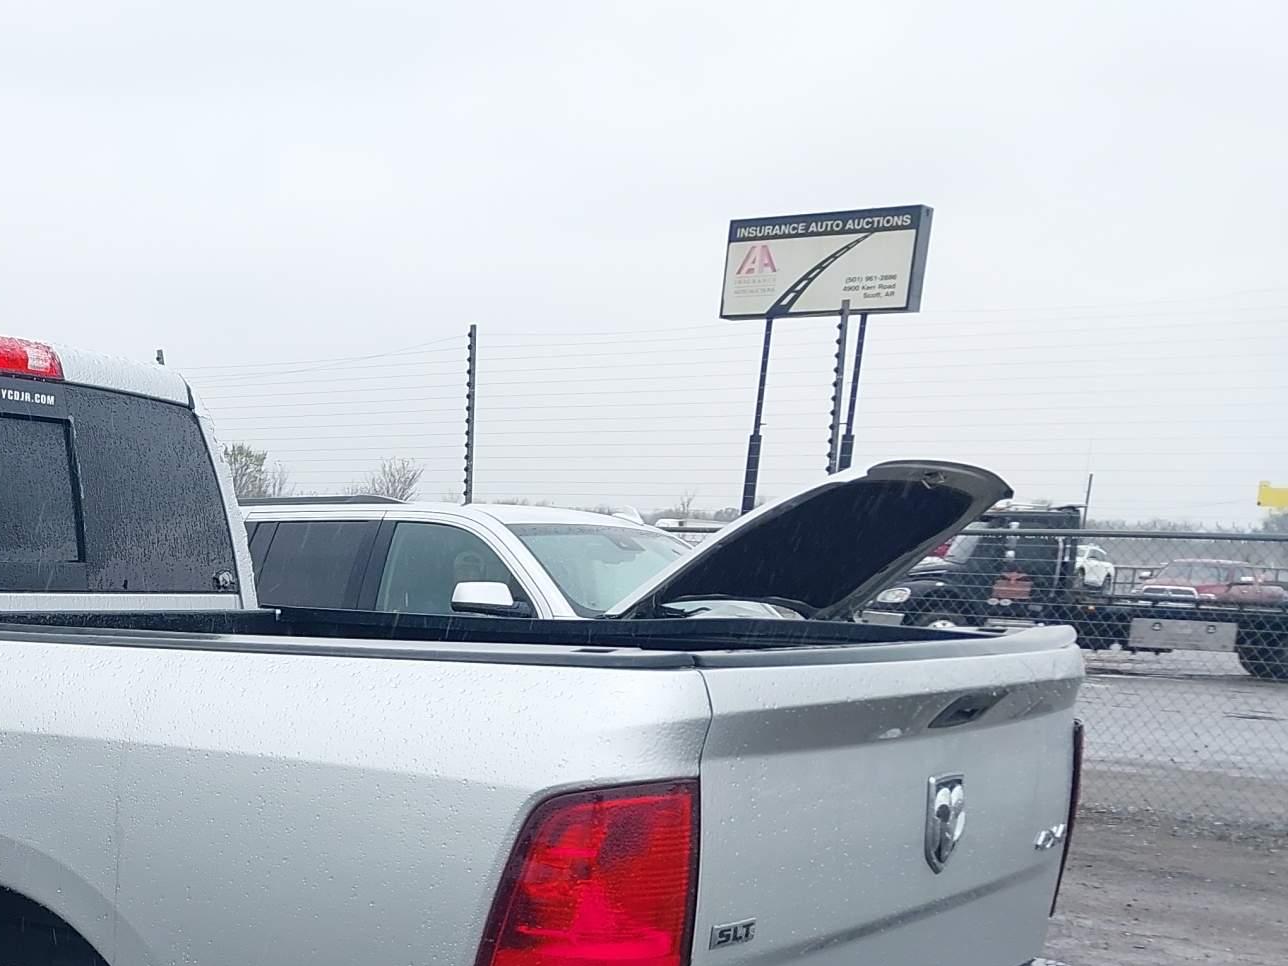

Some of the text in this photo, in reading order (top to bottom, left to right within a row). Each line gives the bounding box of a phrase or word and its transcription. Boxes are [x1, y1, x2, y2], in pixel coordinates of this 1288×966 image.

[736, 214, 913, 239] INSURANCE AUTO AUCTIONS
[878, 282, 897, 290] Road
[717, 922, 754, 945] SLT
